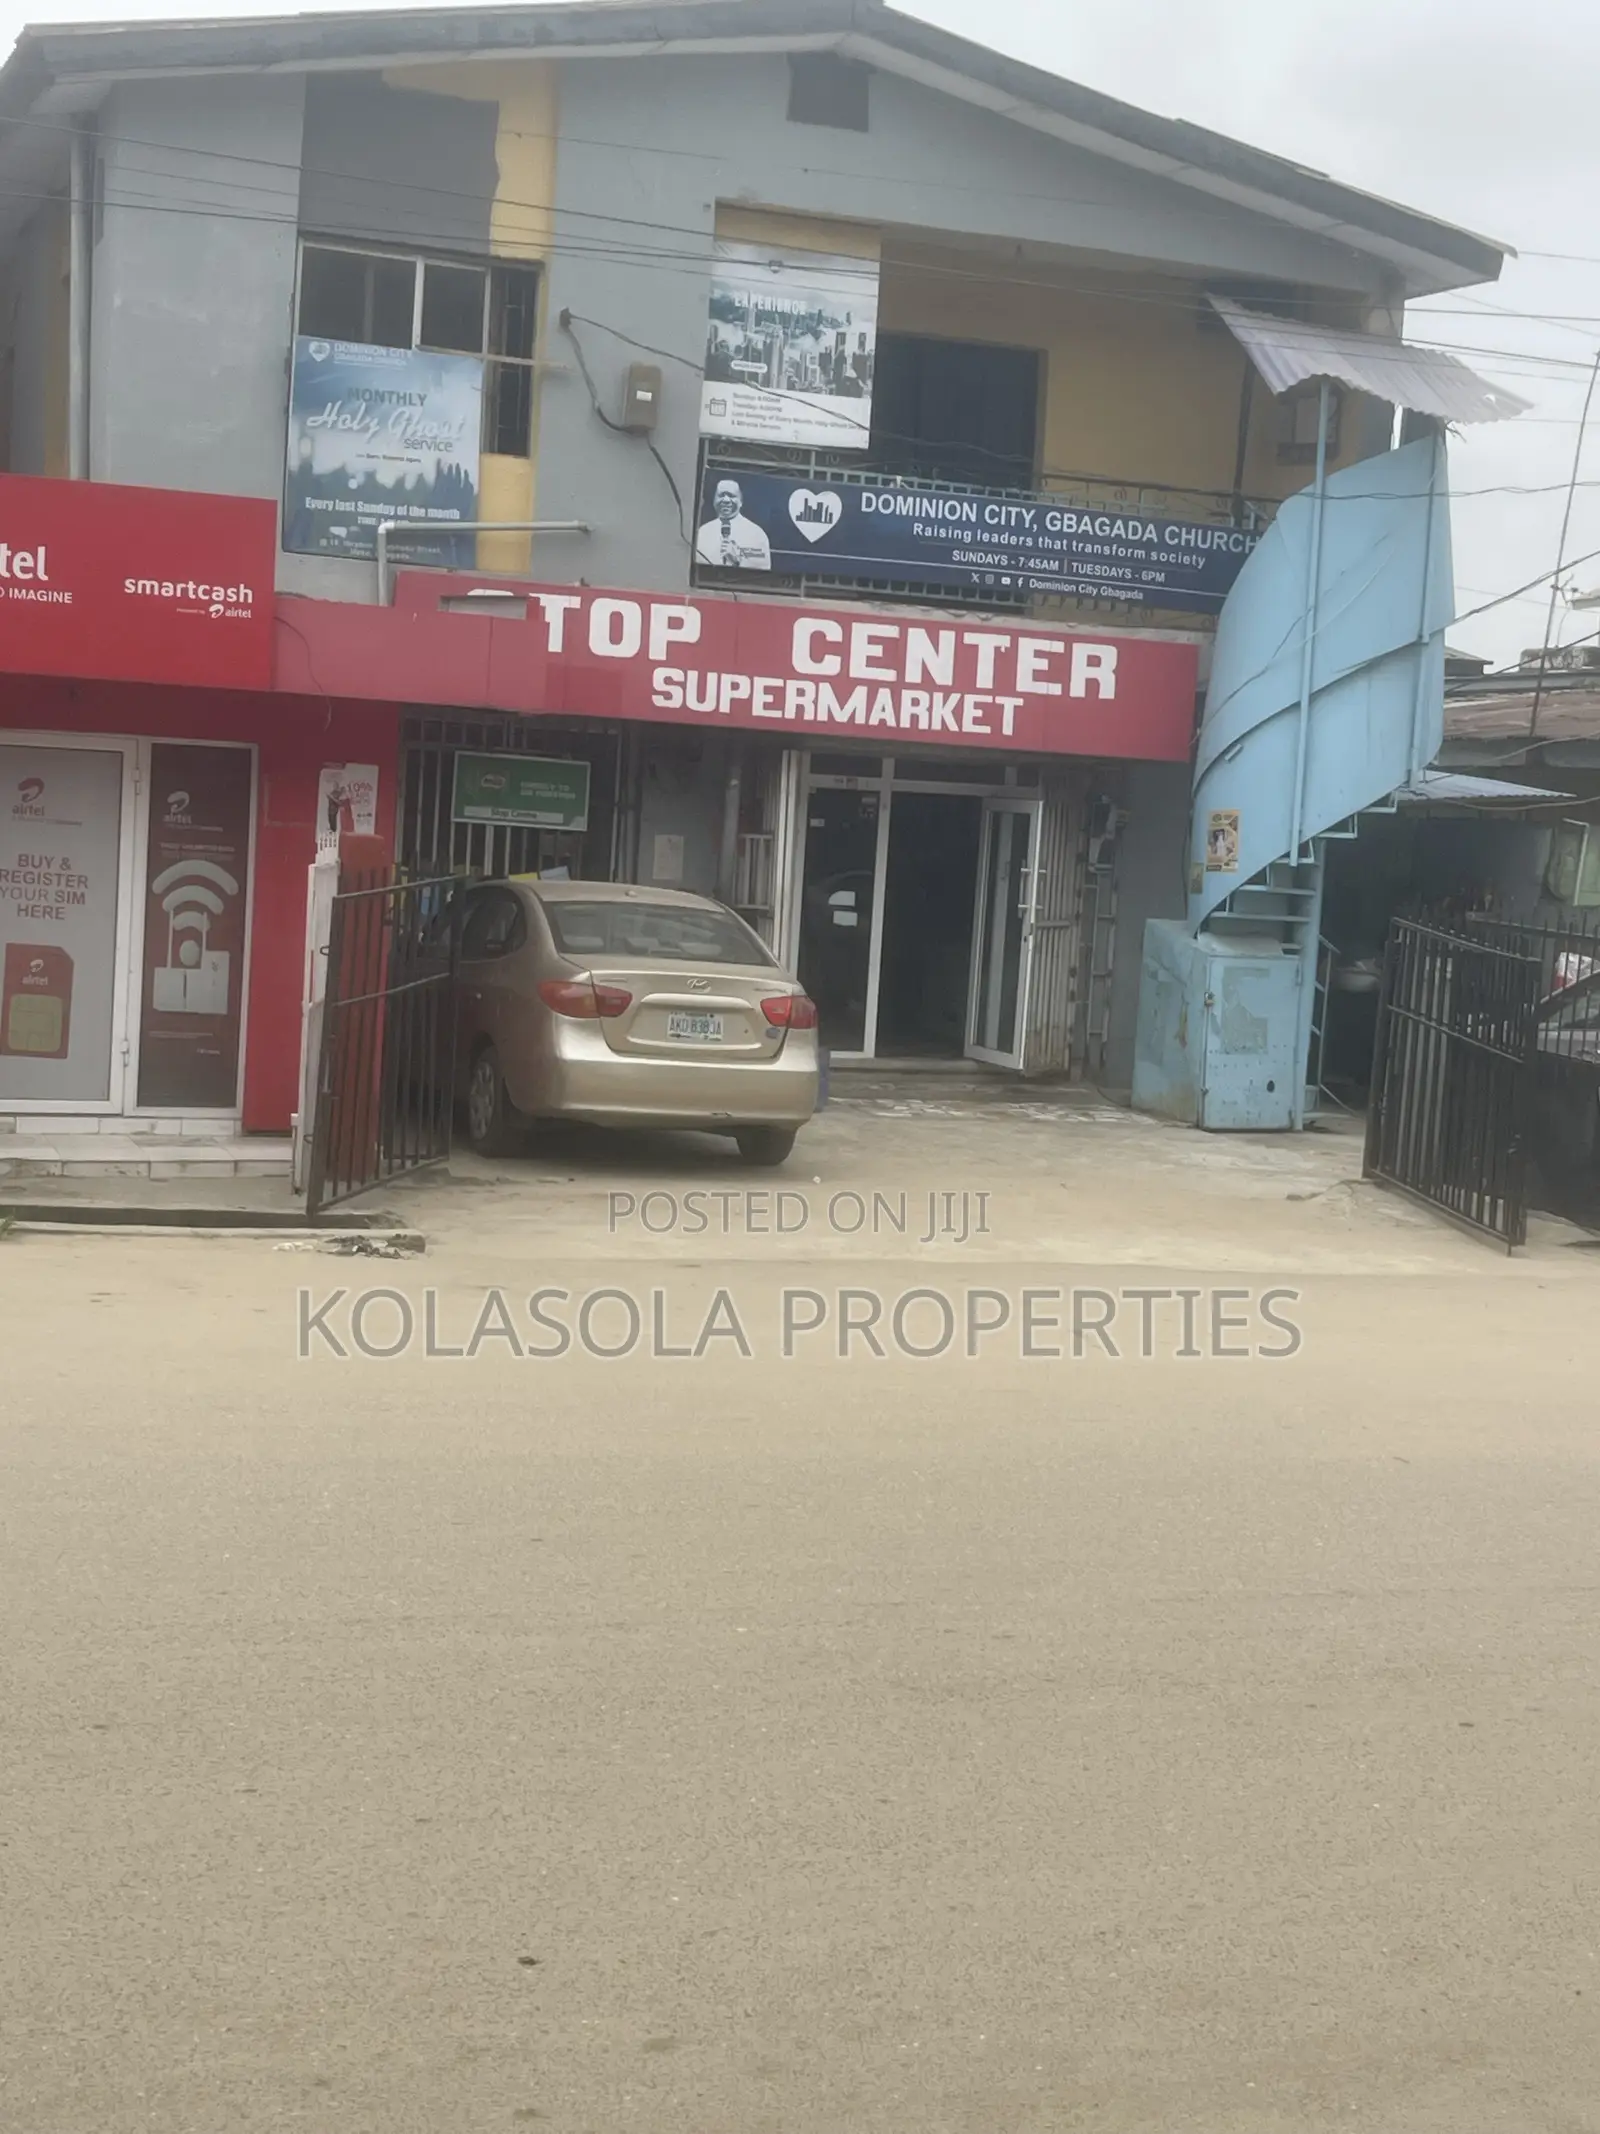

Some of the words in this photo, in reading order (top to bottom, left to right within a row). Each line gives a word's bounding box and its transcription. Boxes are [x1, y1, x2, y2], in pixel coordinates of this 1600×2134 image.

[348, 387, 428, 407] MONTHLY
[306, 400, 381, 444] Holy
[403, 437, 454, 453] service
[305, 497, 334, 512] Every
[335, 499, 356, 512] last
[357, 501, 395, 516] Sunday
[396, 504, 408, 516] of
[409, 505, 426, 517] the
[427, 507, 460, 520] month
[860, 492, 977, 522] DOMINION
[984, 504, 1038, 532] CITY,
[1045, 511, 1159, 543] GBAGADA
[1164, 526, 1260, 554] CHURCH
[913, 523, 972, 543] Raising
[977, 529, 1033, 547] leaders
[1038, 536, 1068, 551] that
[1071, 540, 1146, 559] transform
[1150, 551, 1206, 569] society
[952, 550, 1008, 566] SUNDAYS
[1018, 556, 1060, 571] 7:45AM
[1071, 562, 1132, 579] TUESDAYS
[1141, 570, 1166, 583] 6PM
[9, 587, 73, 604] IMAGINE
[124, 578, 253, 604] smartcash
[1029, 578, 1077, 593] Dominion
[1078, 583, 1098, 597] City
[1100, 585, 1144, 600] Gbagada
[225, 606, 252, 618] airtel
[791, 617, 1118, 699] CENTER
[651, 666, 1024, 736] SUPERMARKET
[12, 803, 45, 817] airtel
[18, 853, 55, 869] BUY
[59, 857, 72, 871] &
[0, 868, 89, 889] REGISTER
[0, 886, 49, 902] YOUR
[54, 889, 86, 905] SIM
[17, 904, 66, 920] HERE
[22, 974, 49, 986] airtel
